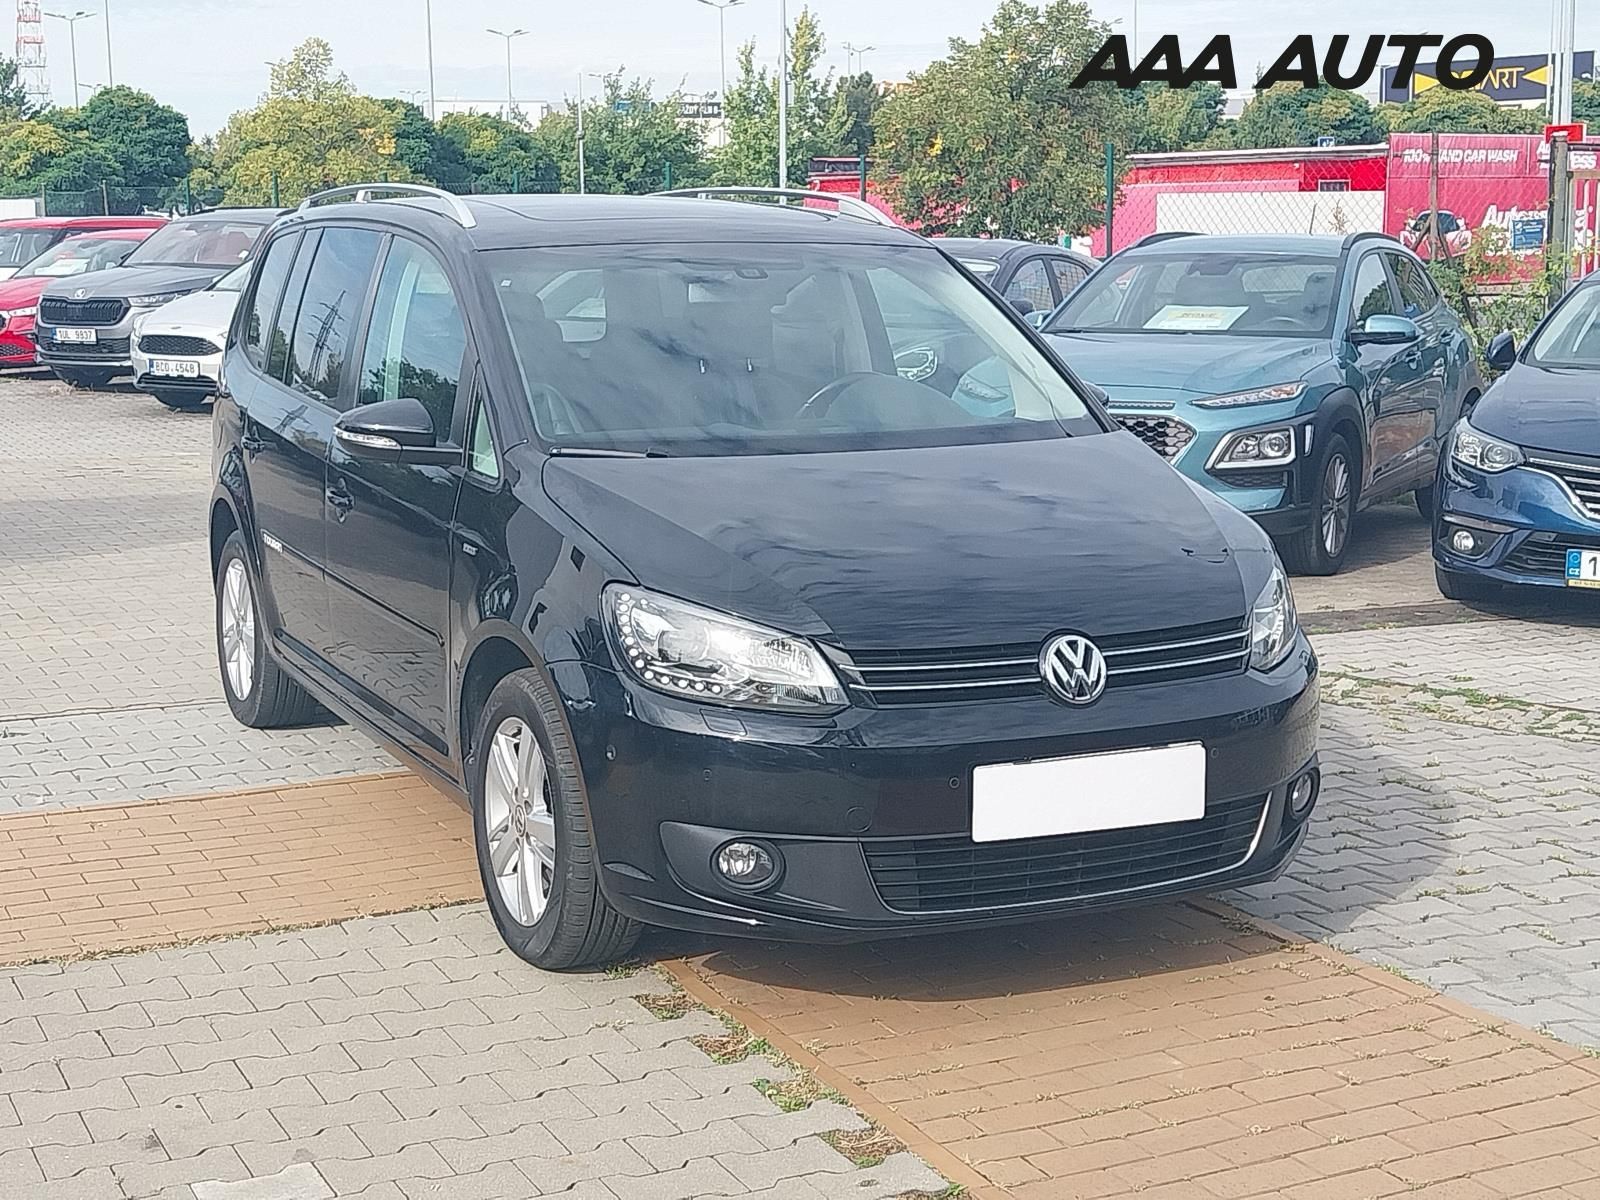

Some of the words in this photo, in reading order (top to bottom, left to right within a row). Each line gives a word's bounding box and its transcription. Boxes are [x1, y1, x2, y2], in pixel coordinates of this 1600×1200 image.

[1433, 149, 1463, 163] AND
[1463, 149, 1487, 163] CAR
[1487, 149, 1519, 163] WASH
